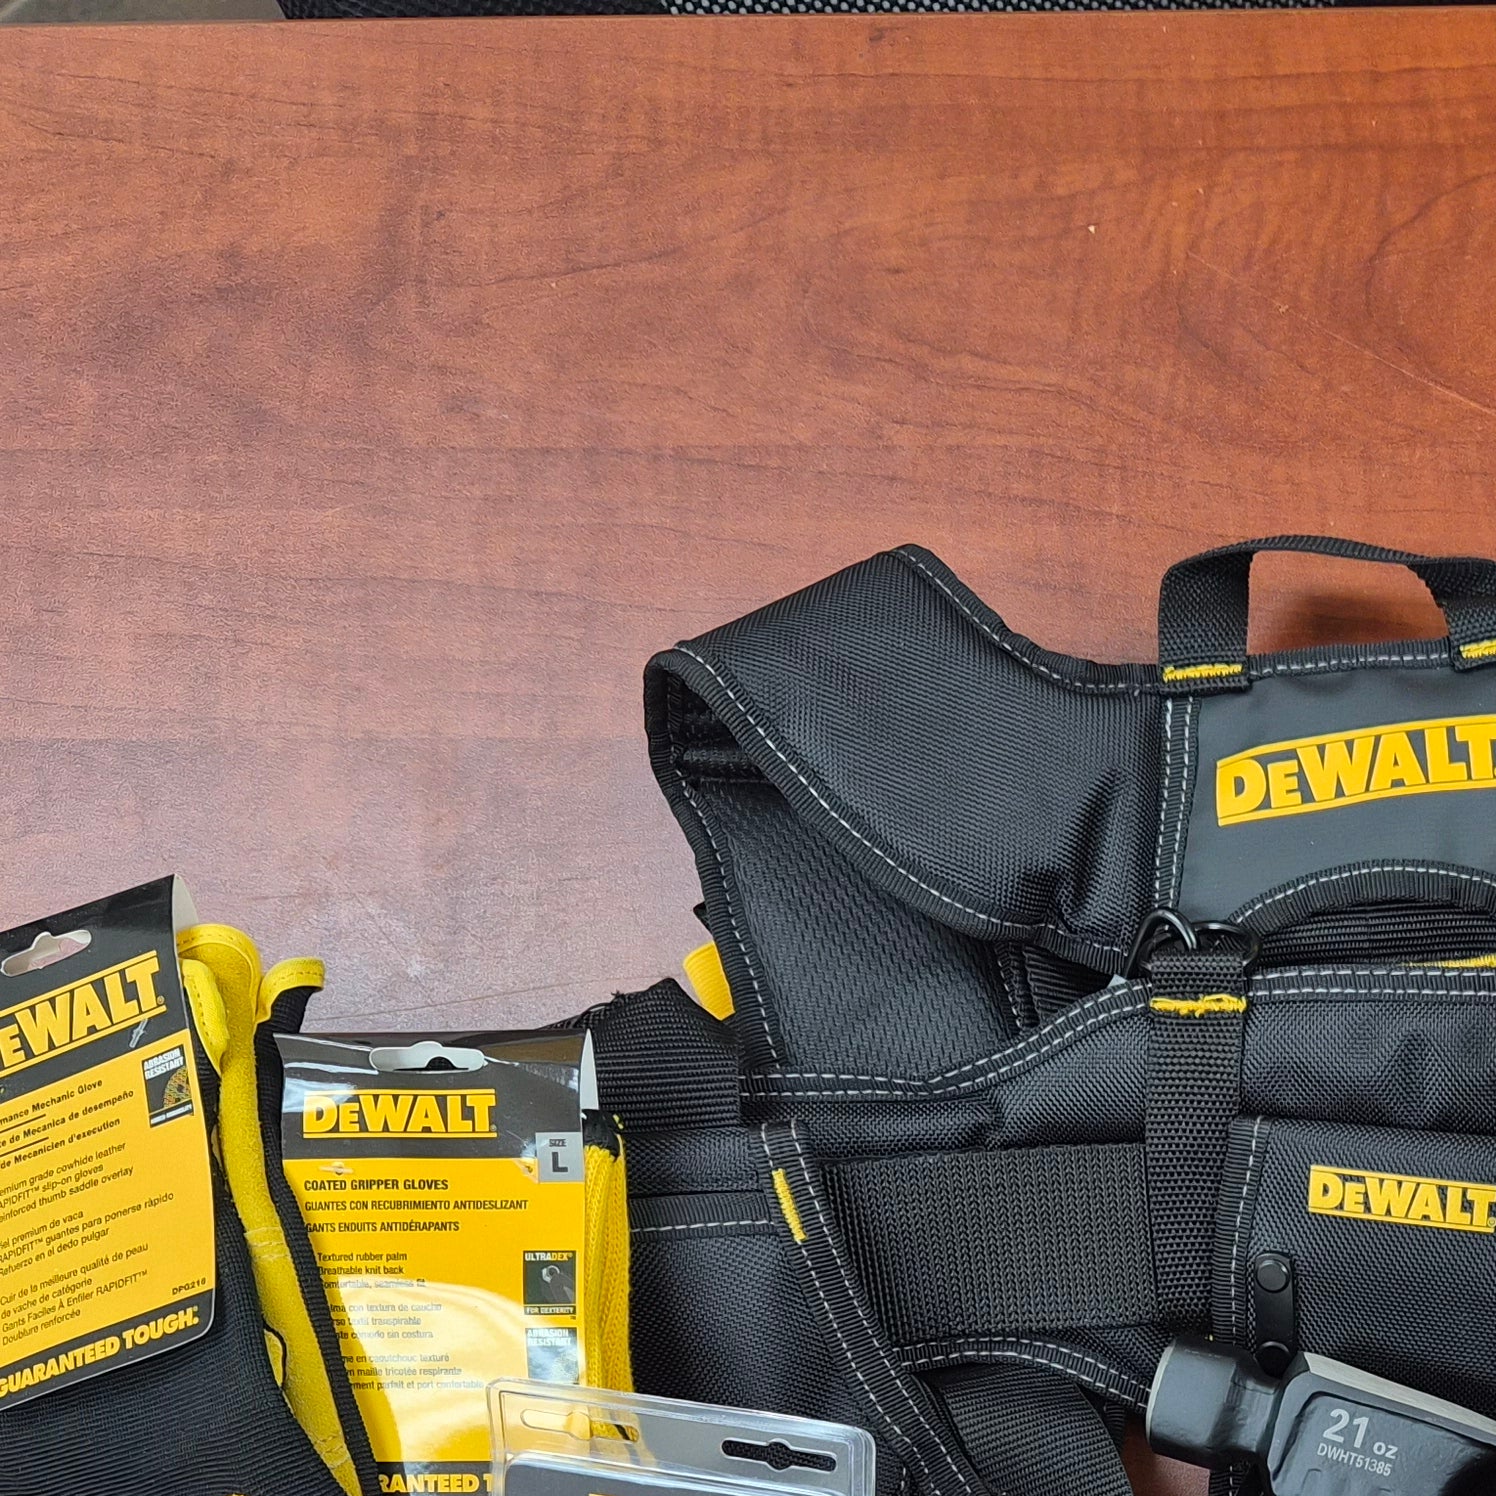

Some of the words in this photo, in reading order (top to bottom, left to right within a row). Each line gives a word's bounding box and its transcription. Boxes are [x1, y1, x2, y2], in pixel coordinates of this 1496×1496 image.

[0, 957, 160, 1067] EWALT
[304, 1094, 496, 1132] DEWALT
[552, 1152, 568, 1172] L
[304, 1180, 347, 1191] COATED
[351, 1180, 399, 1190] GRIPPER
[404, 1179, 448, 1190] GLOVES
[305, 1200, 346, 1211] GUANTES
[350, 1200, 369, 1210] CON
[371, 1200, 450, 1210] RECUBRIMIENTO
[306, 1222, 336, 1232] GANTS
[338, 1222, 377, 1232] ENDUITS
[380, 1220, 460, 1232] ANTIDÉRAPANTS
[318, 1252, 354, 1262] Textured
[356, 1252, 383, 1261] rubber
[386, 1252, 407, 1262] palm
[366, 1265, 381, 1274] knit
[384, 1265, 404, 1274] back
[0, 1336, 120, 1397] GUARANTEED
[1323, 1408, 1370, 1448] 21
[1373, 1442, 1398, 1459] oz
[1317, 1443, 1392, 1476] DWHT51385
[378, 1474, 480, 1492] RANTEED
